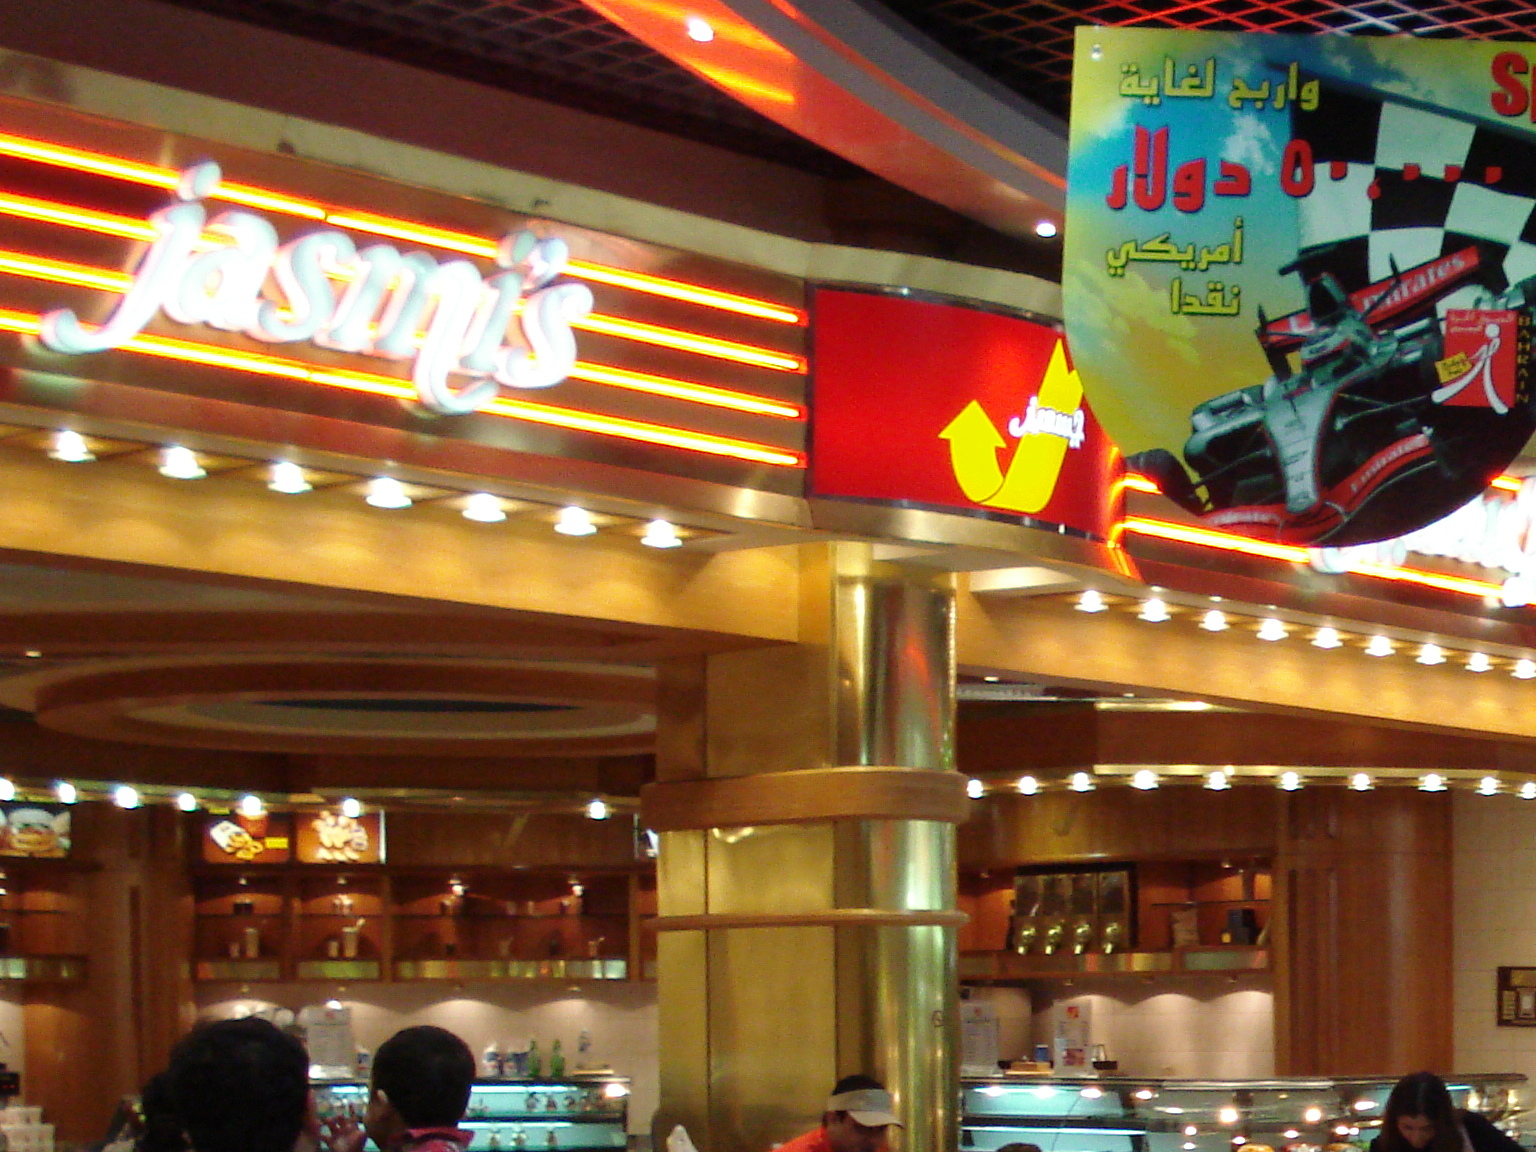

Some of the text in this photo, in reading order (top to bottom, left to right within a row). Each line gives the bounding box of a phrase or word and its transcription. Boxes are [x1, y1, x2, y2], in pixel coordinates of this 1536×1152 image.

[1118, 55, 1321, 110] واربح لغاية
[1105, 123, 1252, 213] دولار
[1105, 216, 1244, 278] أمريكي
[1170, 276, 1242, 317] نقدا
